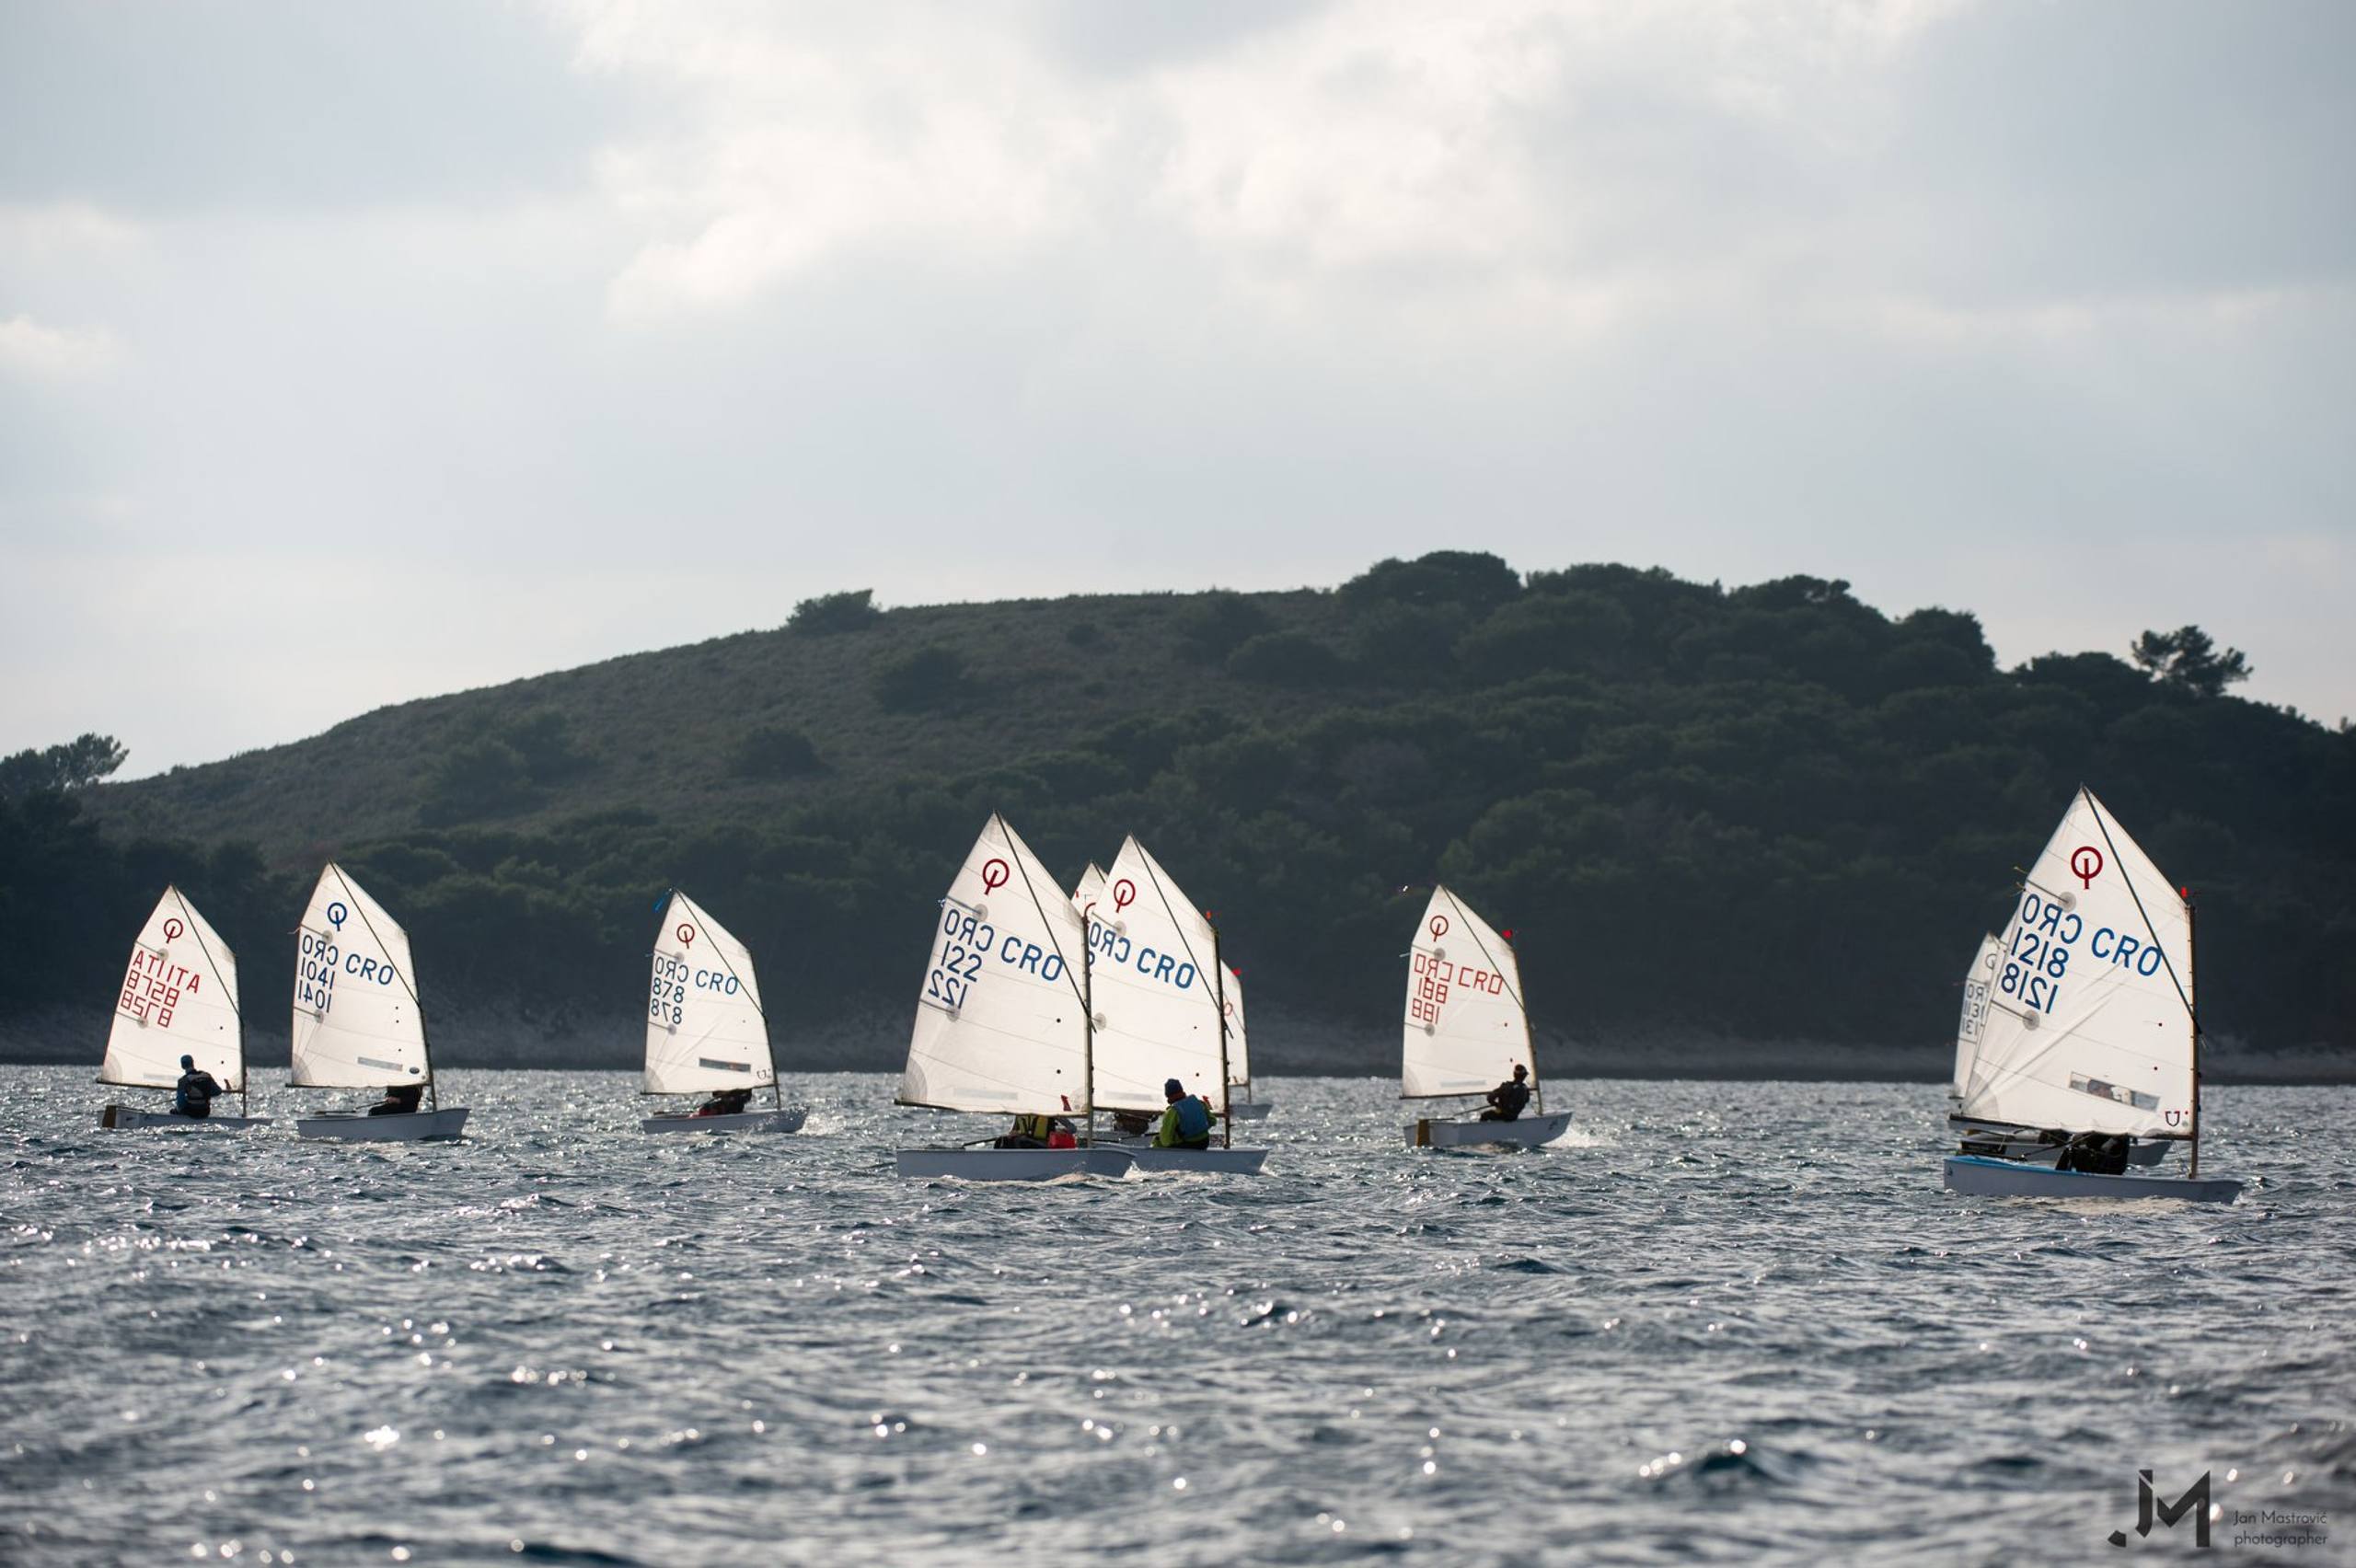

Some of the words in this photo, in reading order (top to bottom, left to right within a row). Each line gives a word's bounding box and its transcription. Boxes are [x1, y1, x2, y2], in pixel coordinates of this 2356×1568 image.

[941, 940, 983, 983] 122
[1000, 936, 1064, 981] CRO
[1137, 947, 1195, 989] CRO
[2011, 927, 2069, 978] 1218
[2091, 927, 2163, 976] CRO
[167, 965, 200, 994] ITA
[301, 957, 335, 990] 1041
[345, 953, 394, 986] CRO
[696, 969, 738, 995] CRO
[1458, 966, 1503, 996] CRO
[126, 969, 180, 1008] 8728
[653, 977, 685, 1003] 878
[1417, 976, 1448, 1004] 188
